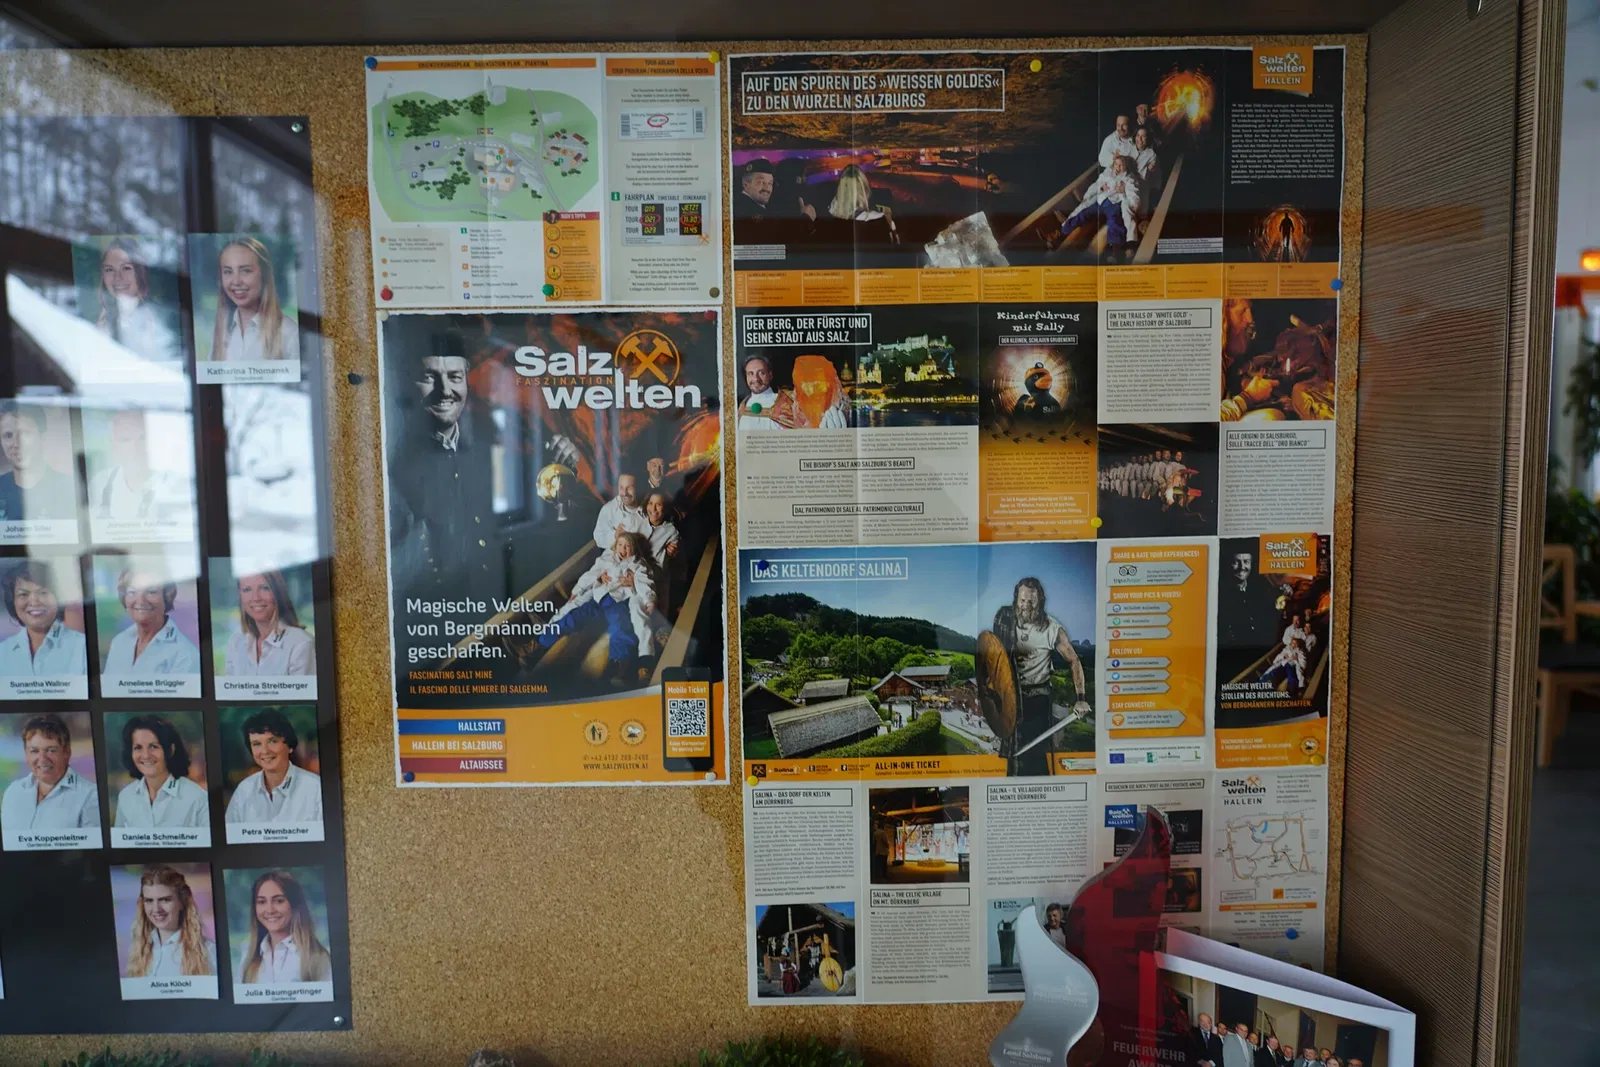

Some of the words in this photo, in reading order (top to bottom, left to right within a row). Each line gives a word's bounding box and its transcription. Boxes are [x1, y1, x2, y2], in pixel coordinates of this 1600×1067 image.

[1259, 56, 1284, 65] Salz
[1266, 62, 1306, 72] welten
[746, 76, 770, 92] AUF
[773, 75, 798, 92] DEN
[801, 74, 850, 91] SPUREN
[853, 74, 877, 90] DES
[880, 74, 943, 89] »WEISSEN
[946, 73, 1000, 88] GOLDES«
[1264, 77, 1301, 85] HALLEIN
[746, 96, 762, 111] ZU
[765, 95, 790, 110] DEN
[792, 94, 851, 110] WURZELN
[854, 93, 926, 108] SALZBURGS
[746, 318, 764, 330] DER
[767, 318, 794, 332] BERG,
[796, 317, 815, 329] DER
[817, 316, 846, 328] FÜRST
[848, 316, 868, 328] UND
[1012, 323, 1032, 332] mit
[1036, 322, 1064, 333] Sally
[746, 333, 773, 344] SEINE
[775, 332, 804, 343] STADT
[806, 331, 825, 343] AUS
[826, 331, 850, 342] SALZ
[514, 345, 613, 376] Salz
[516, 377, 613, 386] FASZINATION
[543, 368, 701, 409] welten
[1266, 541, 1290, 550] Salz
[1272, 548, 1310, 558] welten
[755, 564, 778, 578] DAS
[782, 563, 855, 578] KELTENDORF
[858, 562, 902, 576] SALINA
[1270, 561, 1305, 569] HALLEIN
[406, 598, 486, 618] Magische
[492, 597, 559, 614] Welten,
[407, 624, 438, 636] von
[445, 620, 560, 640] Bergmännern
[408, 642, 506, 663] geschaffen.
[409, 671, 455, 680] FASCINATING
[456, 671, 473, 679] SALT
[475, 671, 492, 679] MINE
[155, 679, 185, 687] Brüggler
[262, 682, 308, 690] Streitberger
[410, 686, 416, 694] IL
[418, 686, 448, 694] FASCINO
[450, 685, 470, 694] DELLE
[472, 685, 498, 693] MINERE
[500, 685, 507, 693] DI
[509, 685, 548, 693] SALGEMMA
[668, 686, 687, 694] Mobile
[1257, 691, 1291, 699] REICHTUMS.
[458, 722, 501, 731] HALLSTATT
[412, 741, 444, 750] HALLEIN
[447, 741, 459, 750] BEI
[462, 741, 503, 750] SALZBURG
[460, 760, 503, 770] ALTAUSSEE
[875, 761, 915, 770] ALL-IN-ONE
[916, 760, 940, 769] TICKET
[1221, 779, 1245, 788] Salz
[1227, 784, 1266, 794] welten
[1224, 798, 1262, 806] HALLEIN
[34, 835, 88, 843] Koppenleitner
[170, 980, 191, 988] Klöckl
[245, 988, 263, 997] Julia
[265, 988, 322, 998] Baumgartinger
[1113, 1041, 1185, 1062] FEUERWEHR
